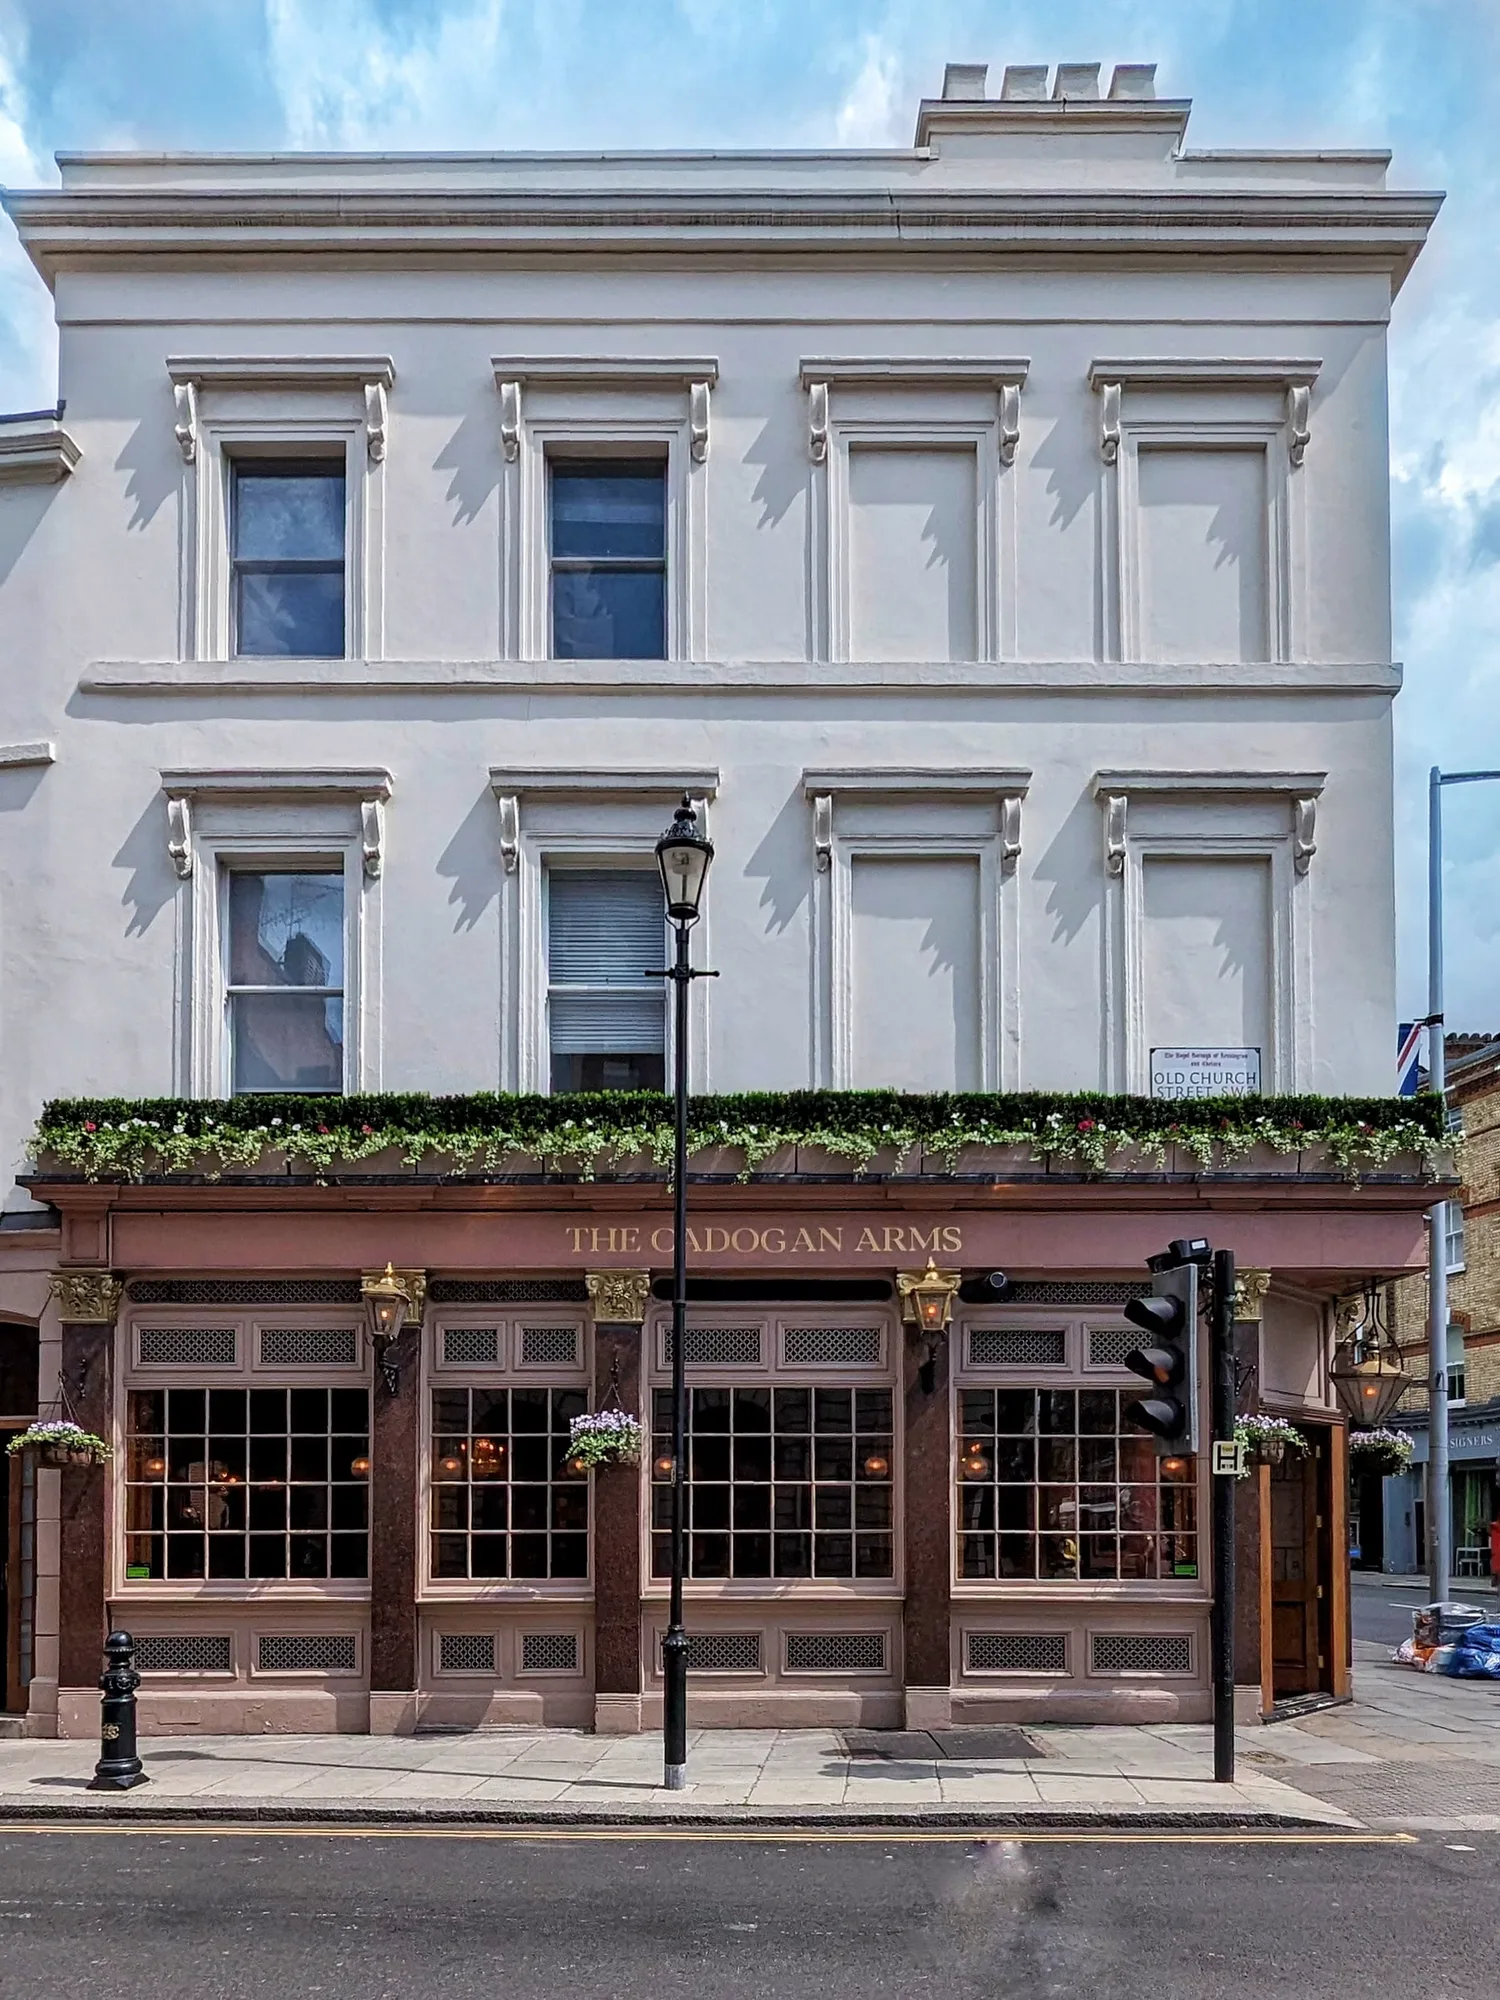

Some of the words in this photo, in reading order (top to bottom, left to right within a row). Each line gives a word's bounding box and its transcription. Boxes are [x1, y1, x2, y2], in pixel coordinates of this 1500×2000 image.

[1154, 1072, 1185, 1085] OLD
[1190, 1072, 1257, 1085] CHURCH
[566, 1227, 641, 1253] THE
[651, 1226, 842, 1254] CADOGAN
[854, 1226, 962, 1253] ARMS
[1449, 1434, 1493, 1449] SIGNERS
